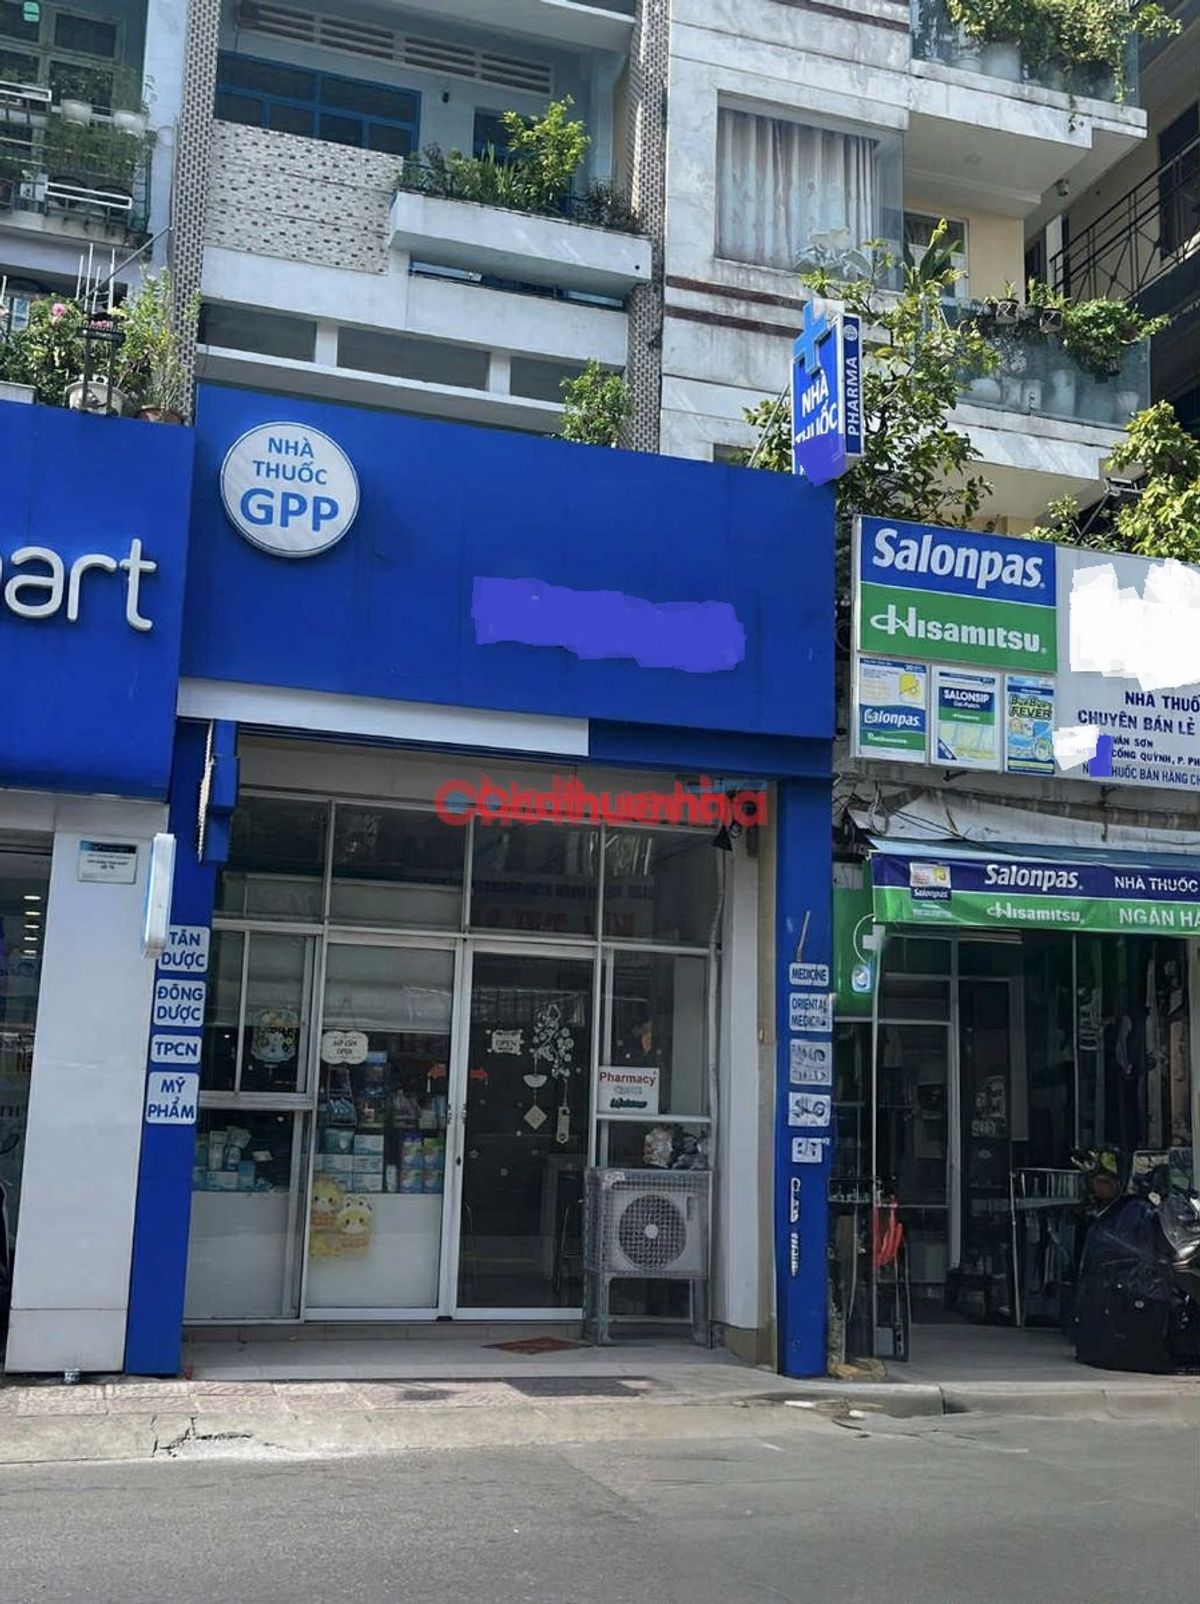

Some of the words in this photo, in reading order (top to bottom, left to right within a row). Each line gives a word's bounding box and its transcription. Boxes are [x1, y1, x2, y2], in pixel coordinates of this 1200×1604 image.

[802, 369, 829, 418] NHÀ
[846, 357, 860, 437] PHARMA
[268, 437, 314, 459] NHÀ
[252, 460, 327, 486] THUỐC
[240, 487, 340, 532] GPP
[872, 527, 1045, 590] Salonpas
[0, 538, 157, 631] art
[870, 604, 1042, 653] Hisamitsu
[943, 688, 990, 703] SALONSIP
[1078, 710, 1137, 730] CHUYÊN
[1143, 715, 1173, 734] BÁN
[985, 864, 1079, 891] Salonpas
[1114, 875, 1146, 889] NHÀ
[1148, 877, 1199, 893] THUỐC
[987, 902, 1081, 923] Hisamitsu
[169, 930, 201, 946] TÂN
[161, 951, 205, 970] DƯỢC
[792, 967, 826, 981] MEDICINE
[157, 984, 203, 1000] ĐÔNG
[157, 1004, 201, 1024] DƯỢC
[155, 1042, 198, 1056] TPCN
[160, 1077, 186, 1094] MỸ
[600, 1072, 656, 1086] Pharmacy
[148, 1098, 195, 1120] PHẨM
